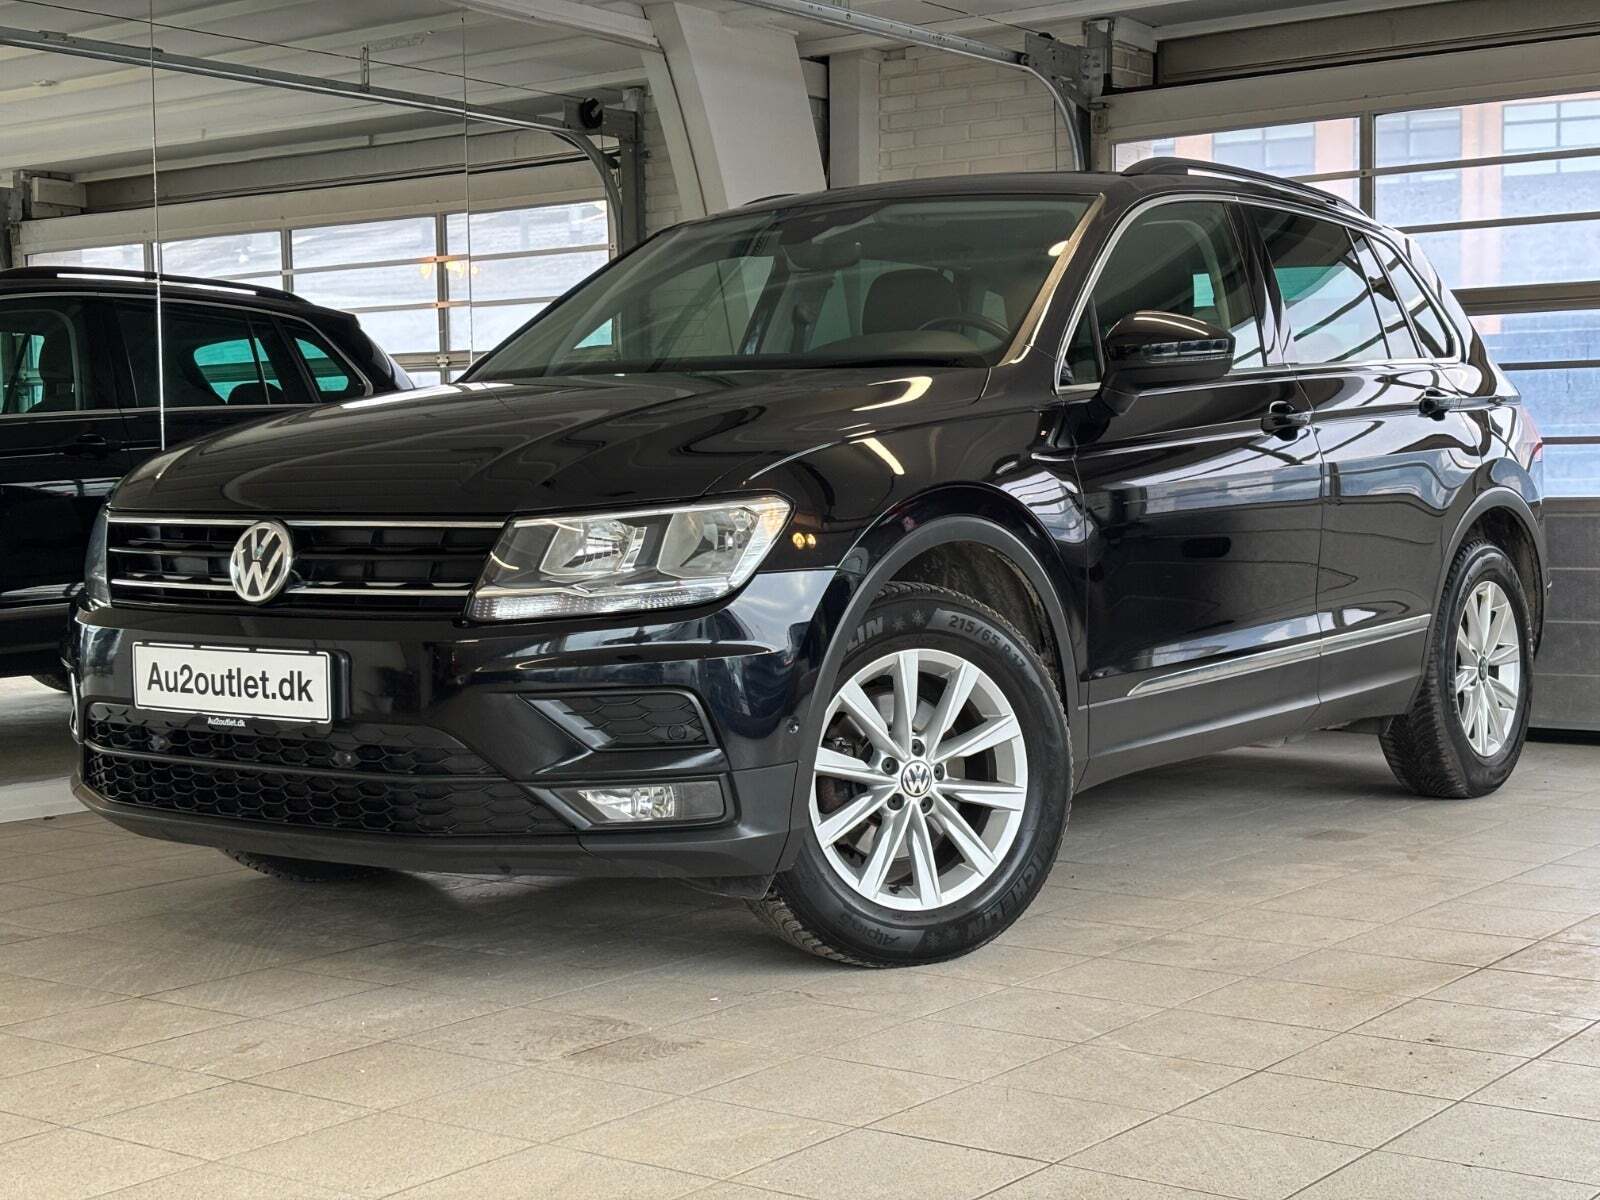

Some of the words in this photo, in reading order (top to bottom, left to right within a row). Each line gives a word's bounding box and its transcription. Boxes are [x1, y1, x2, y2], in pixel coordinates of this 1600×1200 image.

[230, 522, 292, 602] VW
[948, 614, 1001, 647] 215/65
[147, 661, 314, 703] Au2outlet.dk
[901, 760, 932, 797] VW
